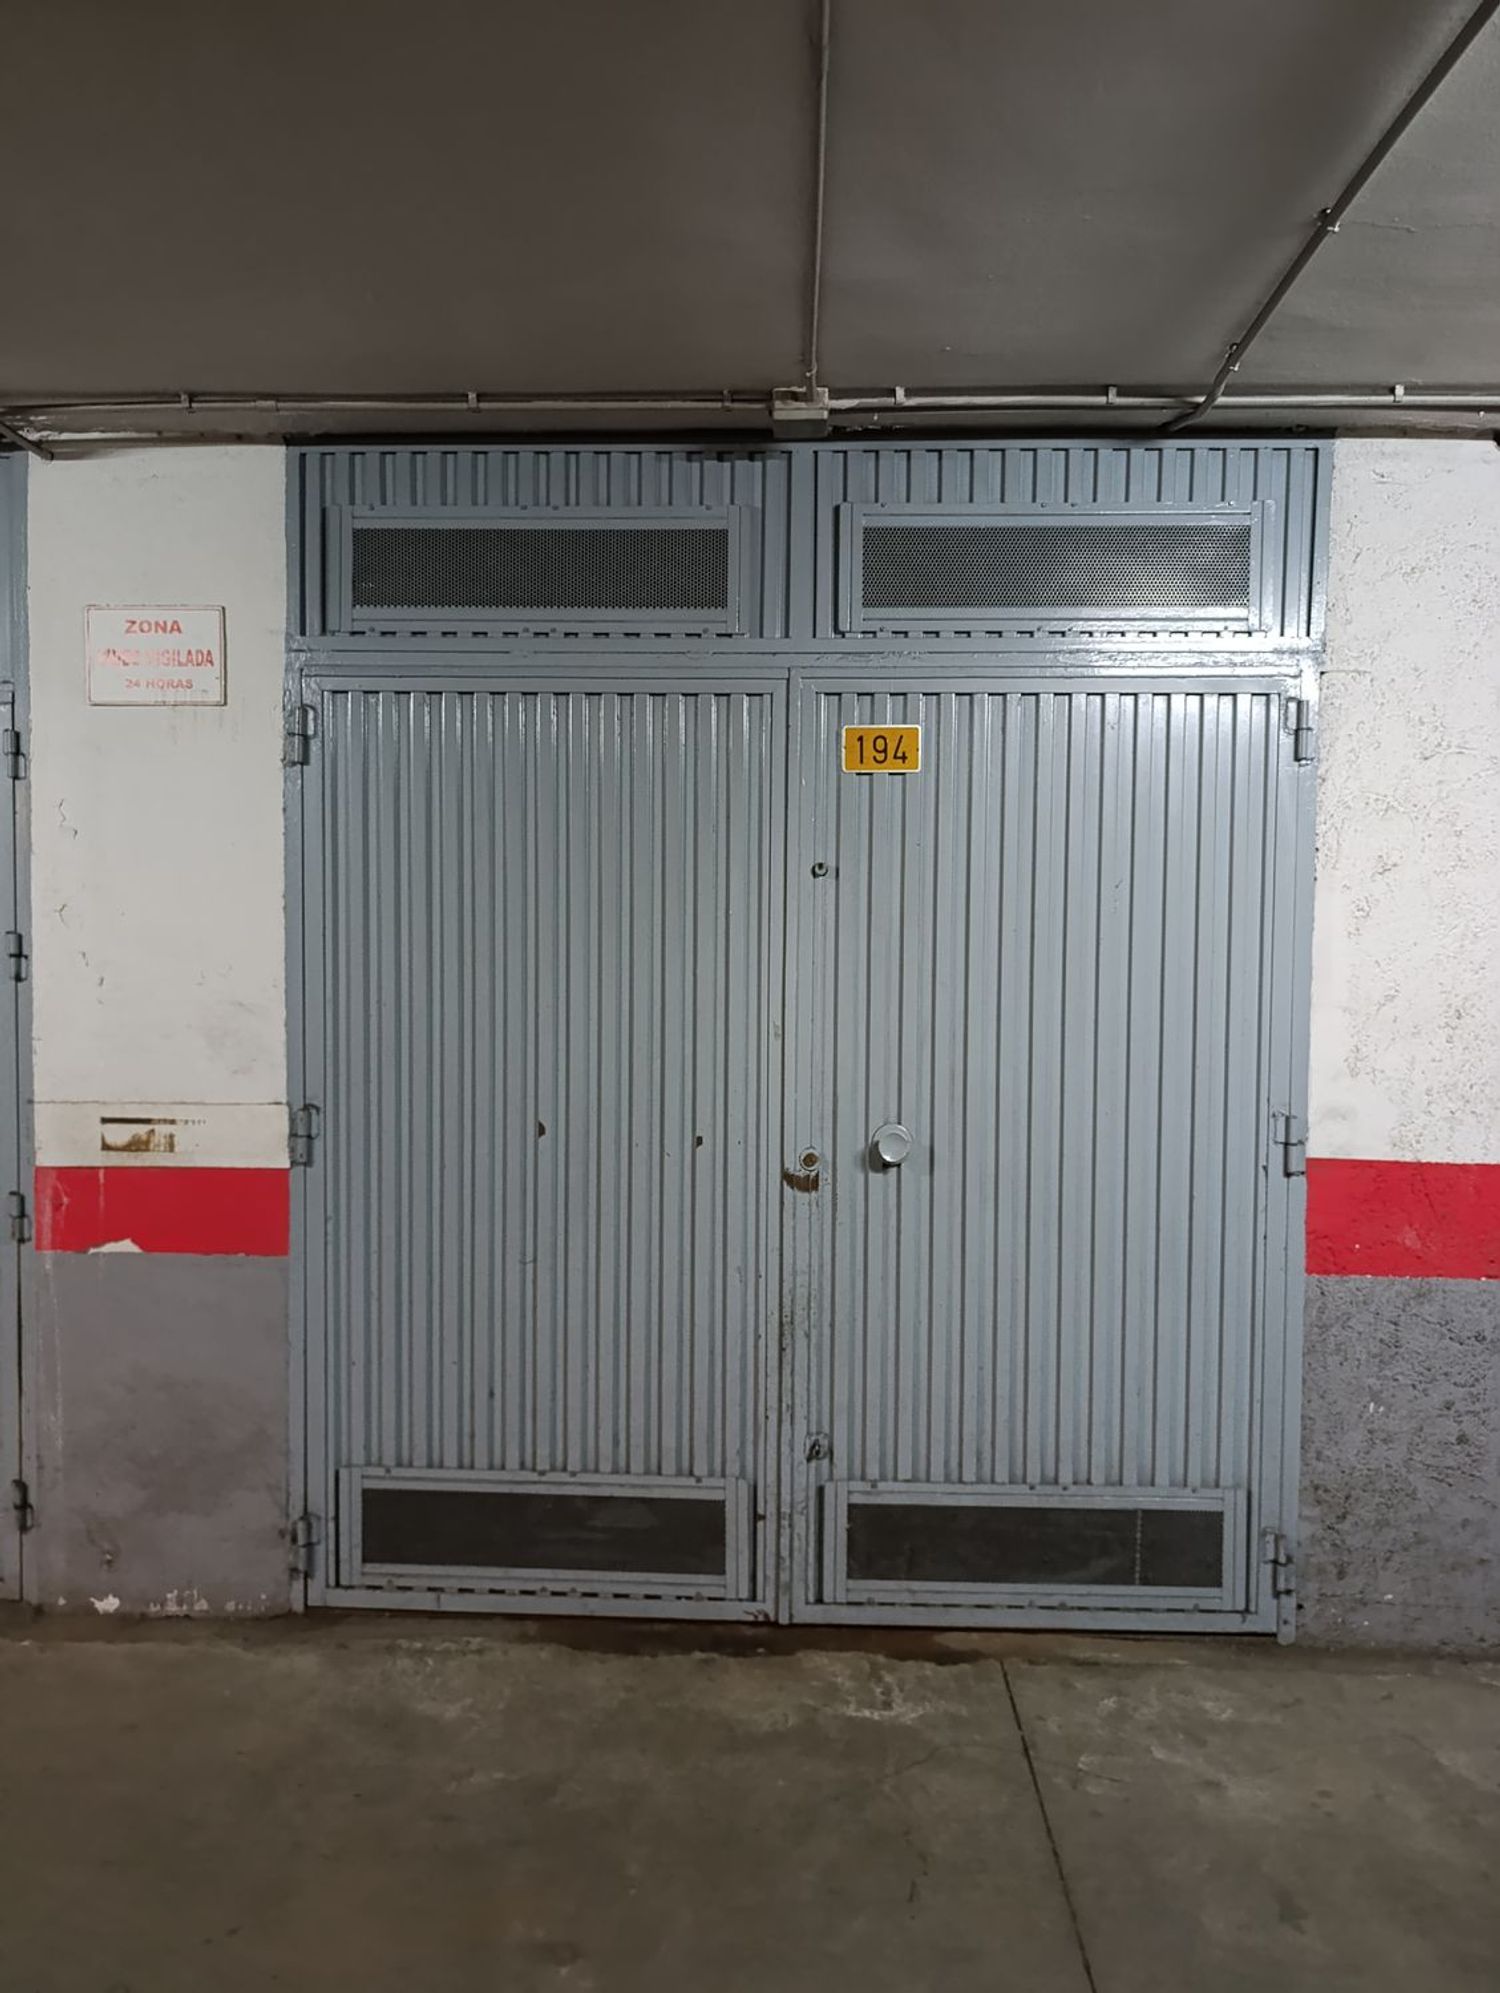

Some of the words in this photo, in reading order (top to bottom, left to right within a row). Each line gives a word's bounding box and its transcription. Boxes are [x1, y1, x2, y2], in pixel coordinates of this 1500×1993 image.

[124, 619, 183, 635] ZONA
[145, 648, 215, 668] IGILADA
[125, 678, 141, 689] 24
[145, 678, 194, 690] HORAS
[857, 734, 908, 765] 194
